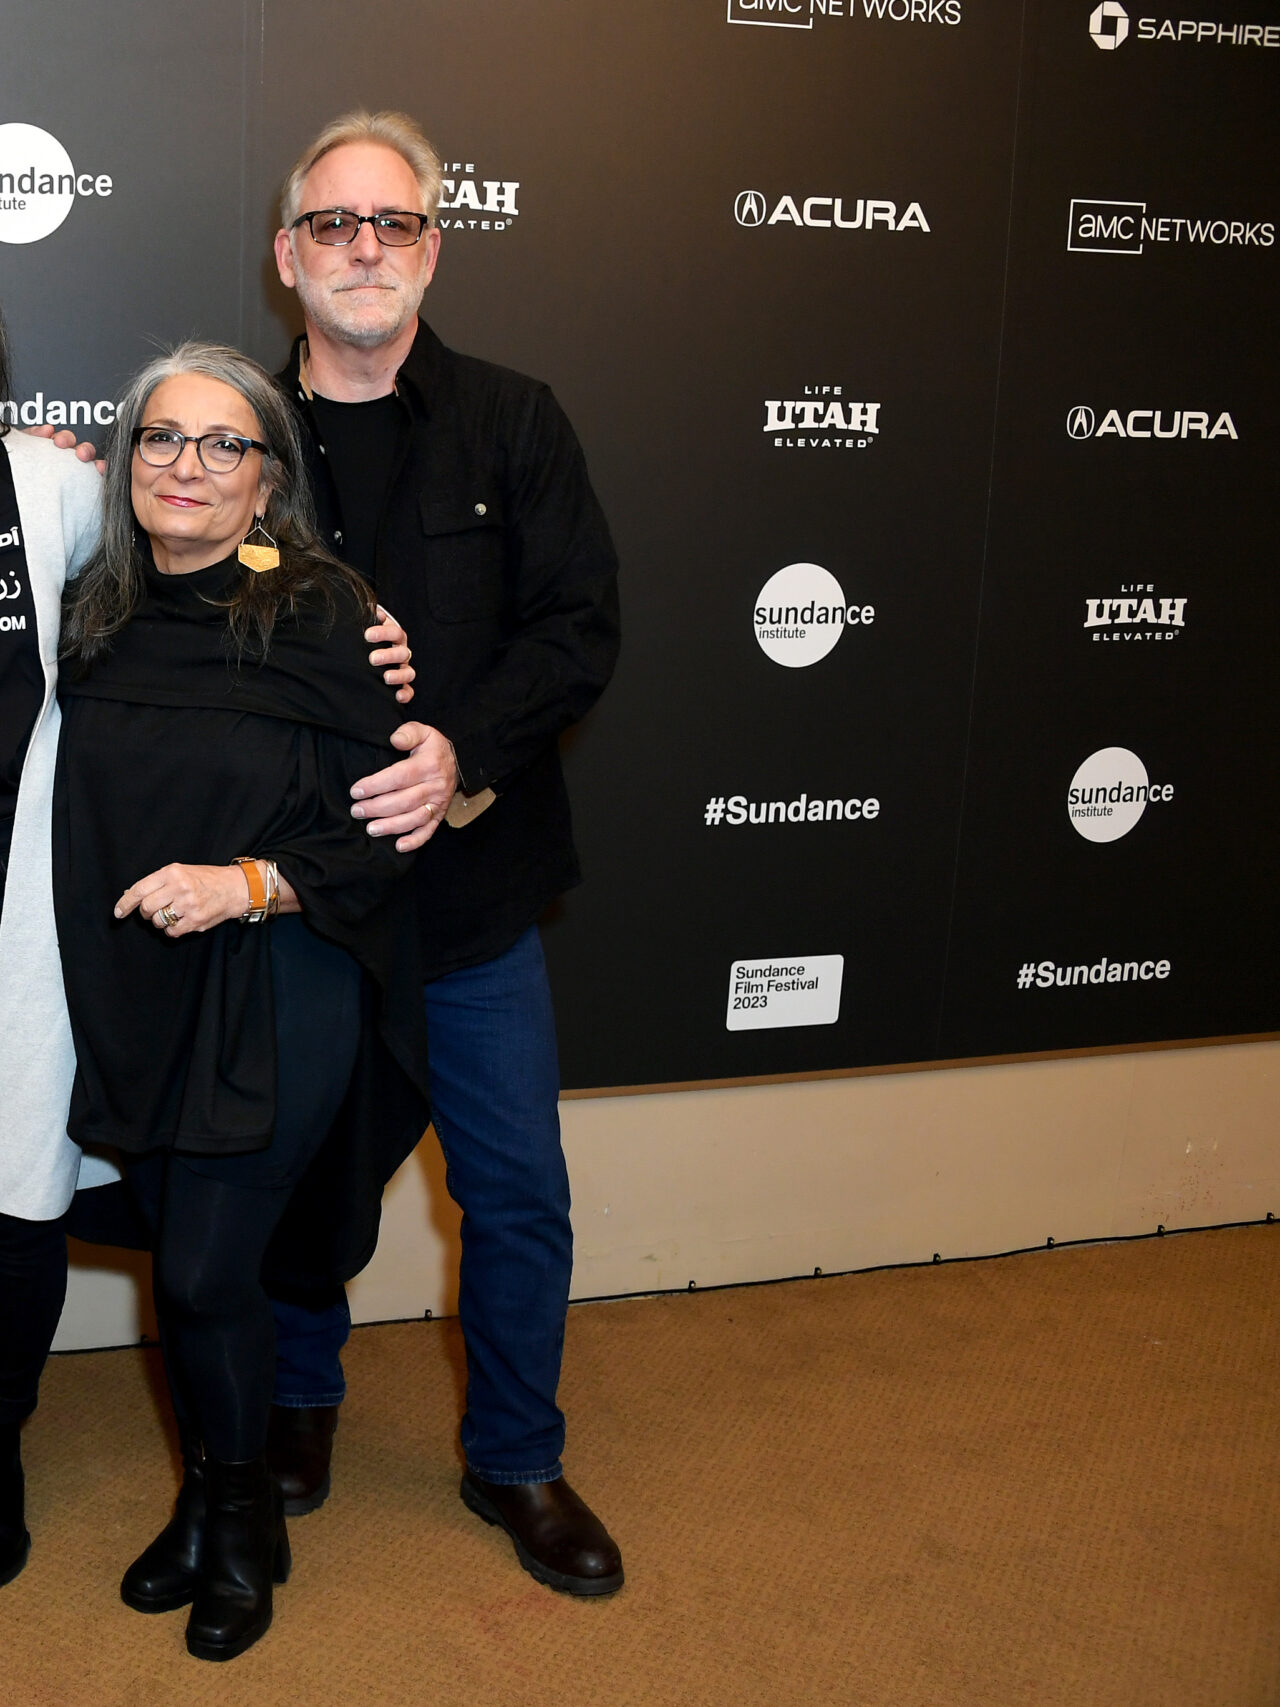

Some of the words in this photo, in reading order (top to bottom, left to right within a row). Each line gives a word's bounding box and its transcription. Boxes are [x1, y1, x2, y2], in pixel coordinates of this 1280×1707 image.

[767, 195, 931, 233] ACURA
[1139, 217, 1276, 247] NETWORKS
[804, 385, 842, 395] LIFE
[763, 400, 881, 434] UTAH
[1094, 409, 1239, 440] ACURA
[1121, 584, 1155, 593] LIFE
[755, 600, 876, 625] sundance
[1083, 598, 1188, 628] UTAH
[759, 626, 807, 639] institute
[1068, 780, 1175, 805] sundance
[703, 793, 881, 827] #Sundance
[1071, 805, 1113, 818] institute
[735, 964, 806, 980] Sundance
[1016, 957, 1172, 989] #Sundance
[734, 981, 764, 995] Film
[766, 976, 819, 993] Festival
[732, 995, 768, 1010] 2023
